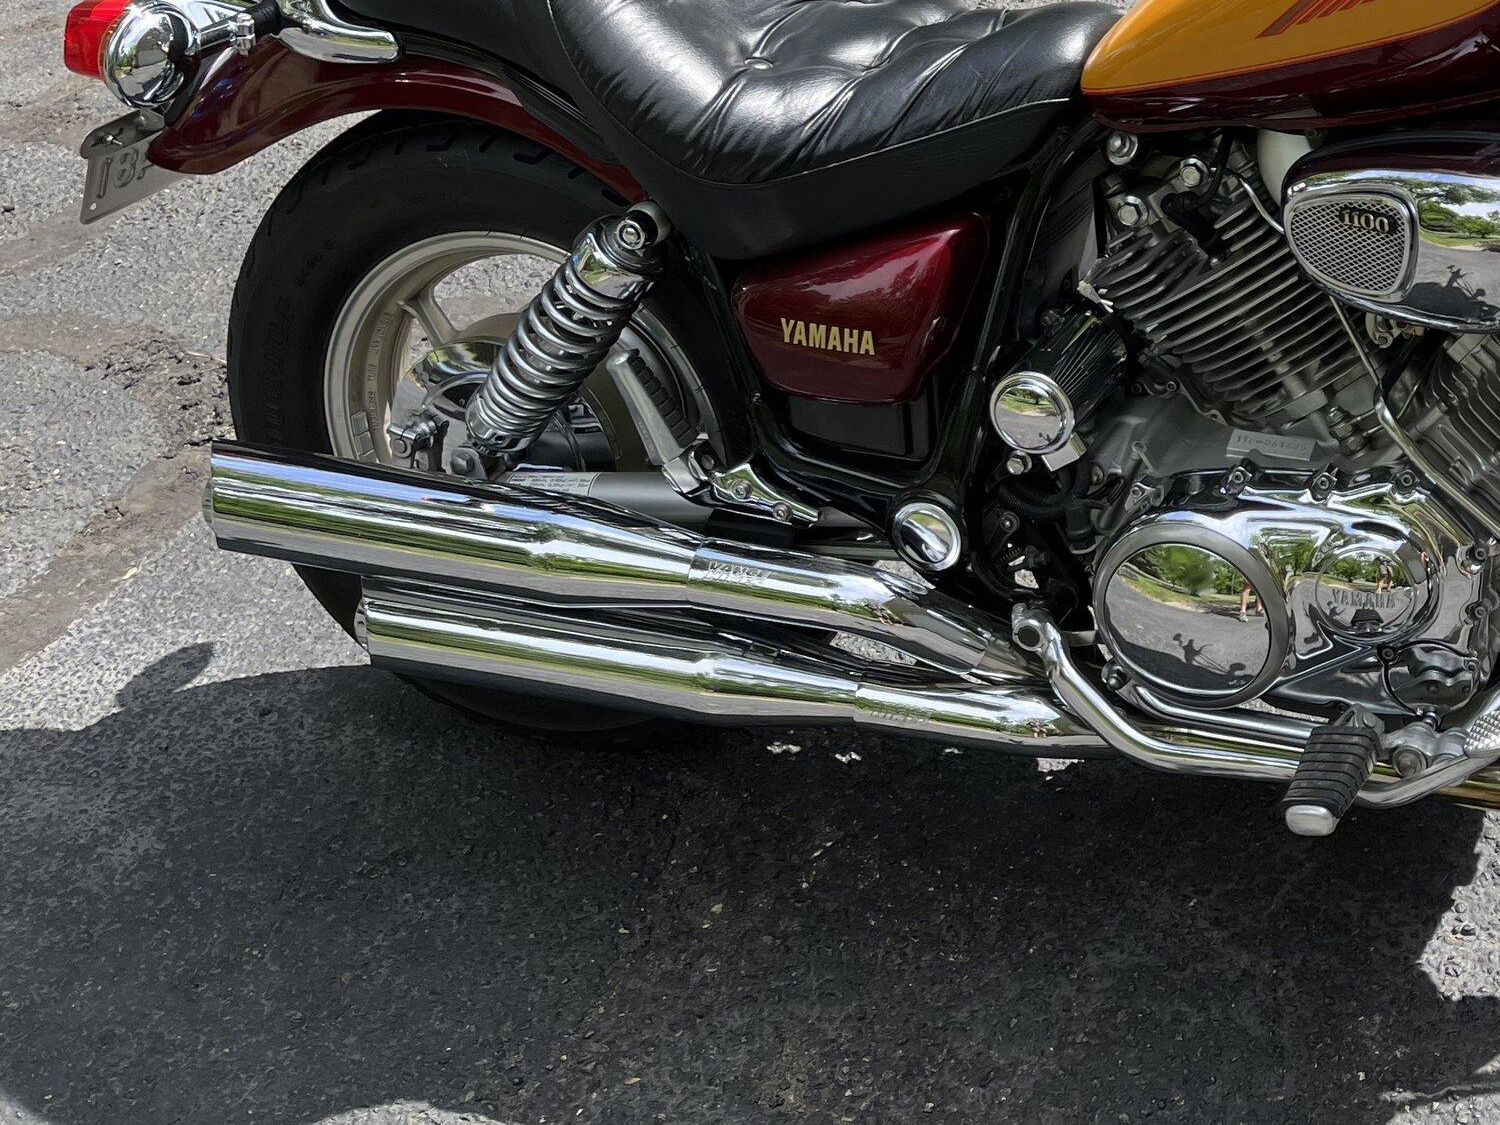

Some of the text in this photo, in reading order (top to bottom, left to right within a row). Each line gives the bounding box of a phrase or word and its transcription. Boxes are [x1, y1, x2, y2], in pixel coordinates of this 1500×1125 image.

[1342, 209, 1390, 233] 1100
[780, 317, 875, 355] YAMAHA
[1331, 588, 1396, 608] YAMAHA
